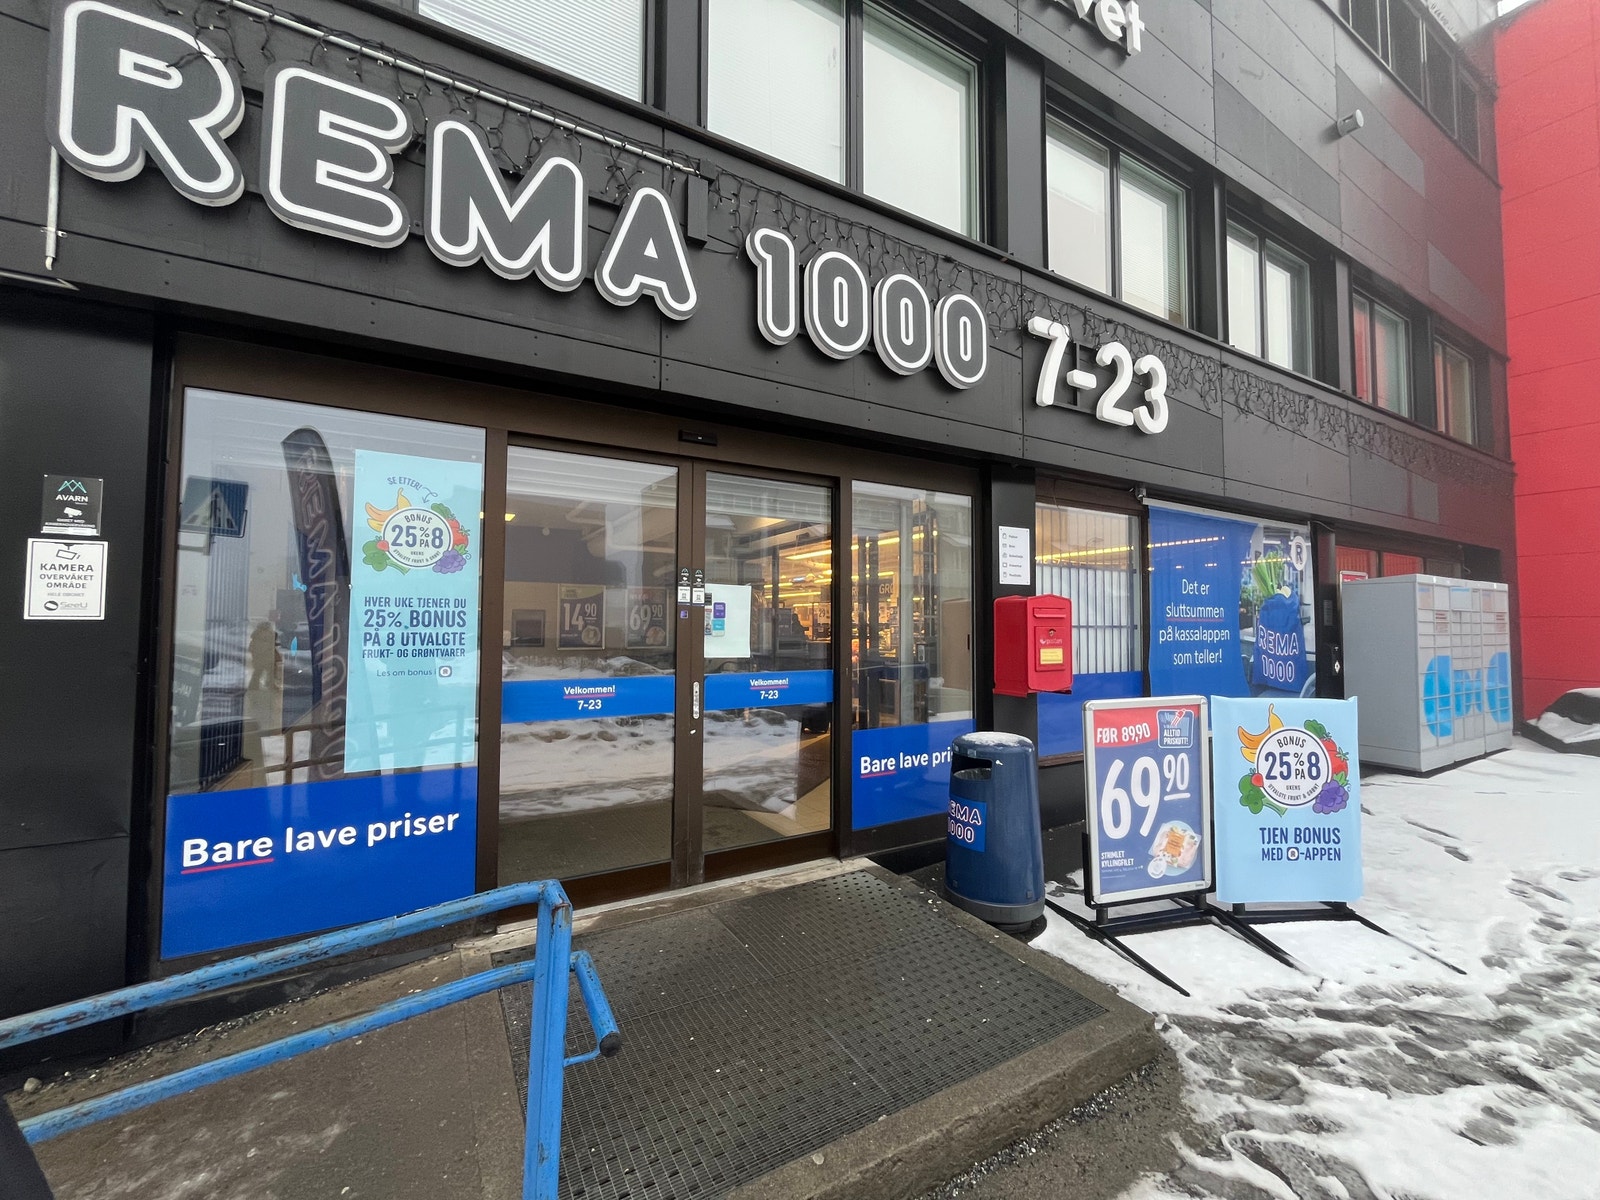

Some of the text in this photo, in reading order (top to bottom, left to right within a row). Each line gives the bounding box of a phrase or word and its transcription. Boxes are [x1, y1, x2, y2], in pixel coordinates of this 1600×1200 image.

[51, 0, 988, 389] REMA 1000
[1027, 316, 1169, 434] 7-23
[387, 476, 423, 491] SE ETTER!
[56, 494, 88, 503] AVARN
[404, 513, 433, 525] BONUS
[391, 524, 417, 548] 25
[431, 527, 444, 549] 8
[40, 563, 94, 572] KAMERA
[40, 573, 94, 581] OVERVÅKET
[46, 581, 87, 589] OMRÅDE
[1182, 579, 1210, 596] Det er
[364, 596, 467, 609] HVER UKE TJENER DU
[1166, 602, 1225, 619] sluttsummen
[363, 609, 467, 628] 25% BONUS
[563, 602, 597, 631] 14 90
[629, 604, 663, 631] 69 90
[363, 627, 466, 647] PÅ 8 UTVALGTE
[1159, 625, 1230, 644] på kassalappen
[1258, 624, 1299, 656] REMA
[362, 648, 466, 659] FRUKT- OG GRØNTVARER
[1173, 648, 1223, 665] som teller!
[376, 669, 391, 677] Les
[407, 667, 433, 676] bonus
[1261, 654, 1295, 682] 1000
[563, 684, 616, 695] Velkommen!
[749, 677, 789, 687] Velkommen!
[760, 690, 779, 700] 7-23
[577, 699, 602, 710] 7-23
[1096, 722, 1151, 744] FØR 89,90
[1163, 728, 1181, 737] ALLTID
[1276, 735, 1307, 749] BONUS
[860, 756, 896, 774] Bare
[899, 752, 929, 769] lave
[1264, 751, 1292, 781] 25
[1306, 751, 1321, 781] 8
[1101, 752, 1190, 839] 69 90
[182, 812, 460, 868] Bare lave priser
[1258, 826, 1341, 845] TJEN BONUS
[1261, 847, 1284, 861] MED
